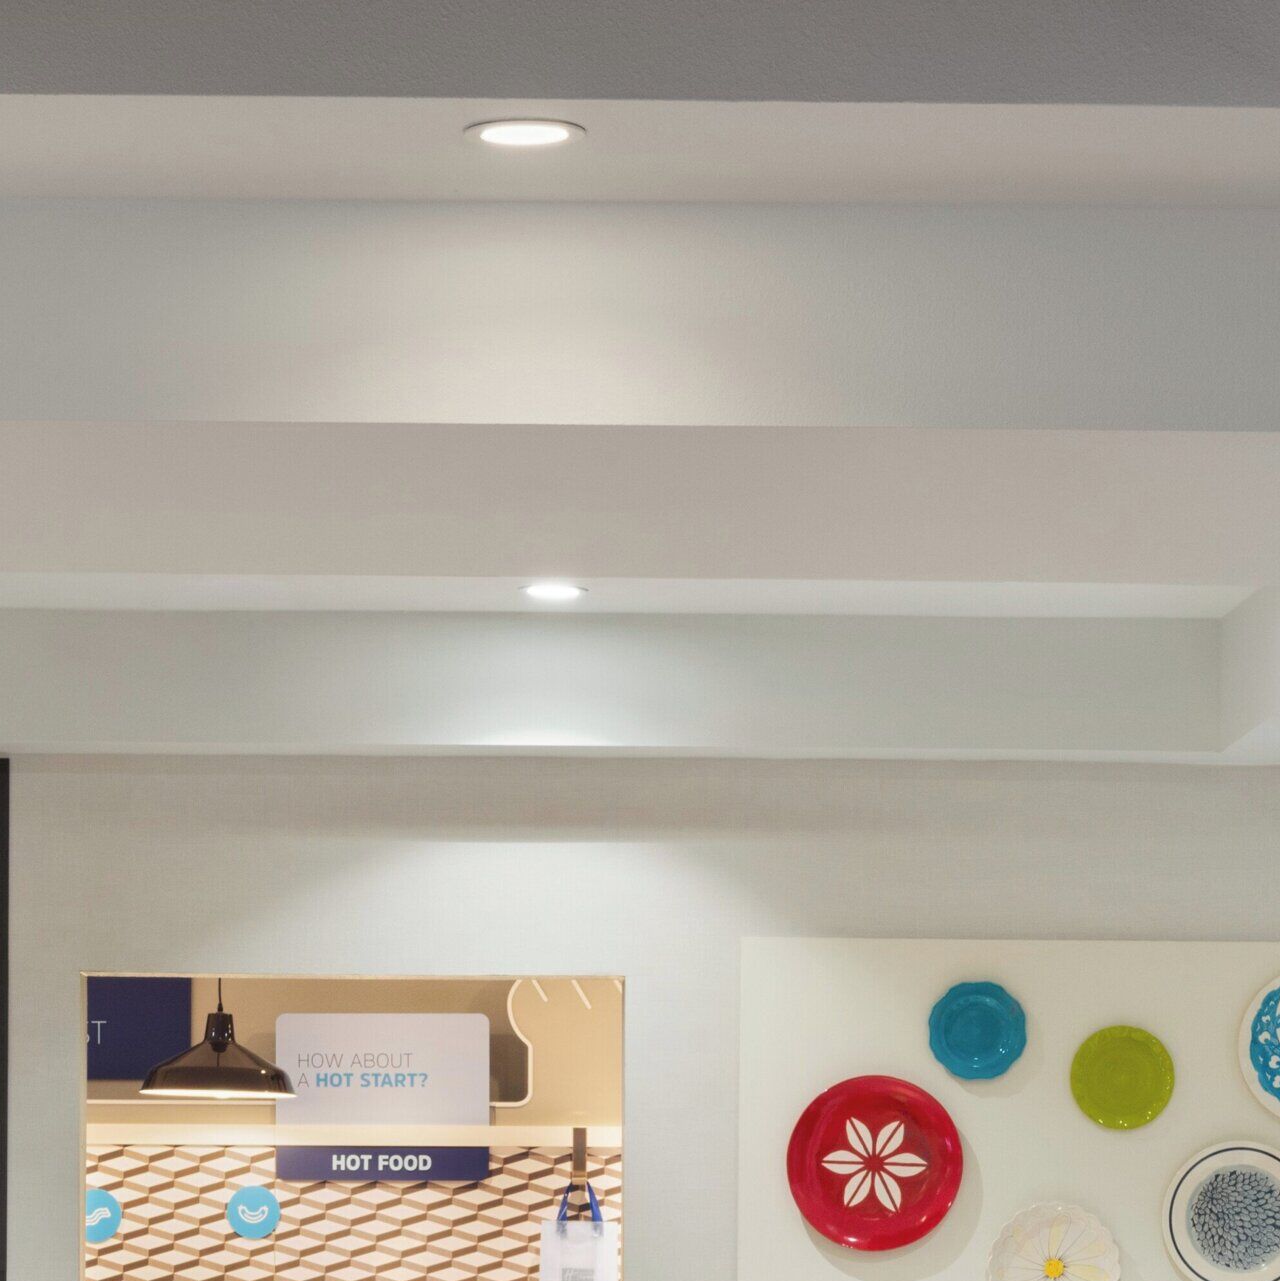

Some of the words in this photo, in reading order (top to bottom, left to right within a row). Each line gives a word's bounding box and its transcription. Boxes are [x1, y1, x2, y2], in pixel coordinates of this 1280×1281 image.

[87, 1020, 107, 1045] T
[297, 1053, 344, 1069] HOW
[350, 1053, 413, 1069] ABOUT
[297, 1073, 309, 1088] A
[315, 1073, 353, 1088] HOT
[360, 1073, 428, 1088] START?
[332, 1154, 372, 1171] HOT
[378, 1154, 432, 1171] FOOD
